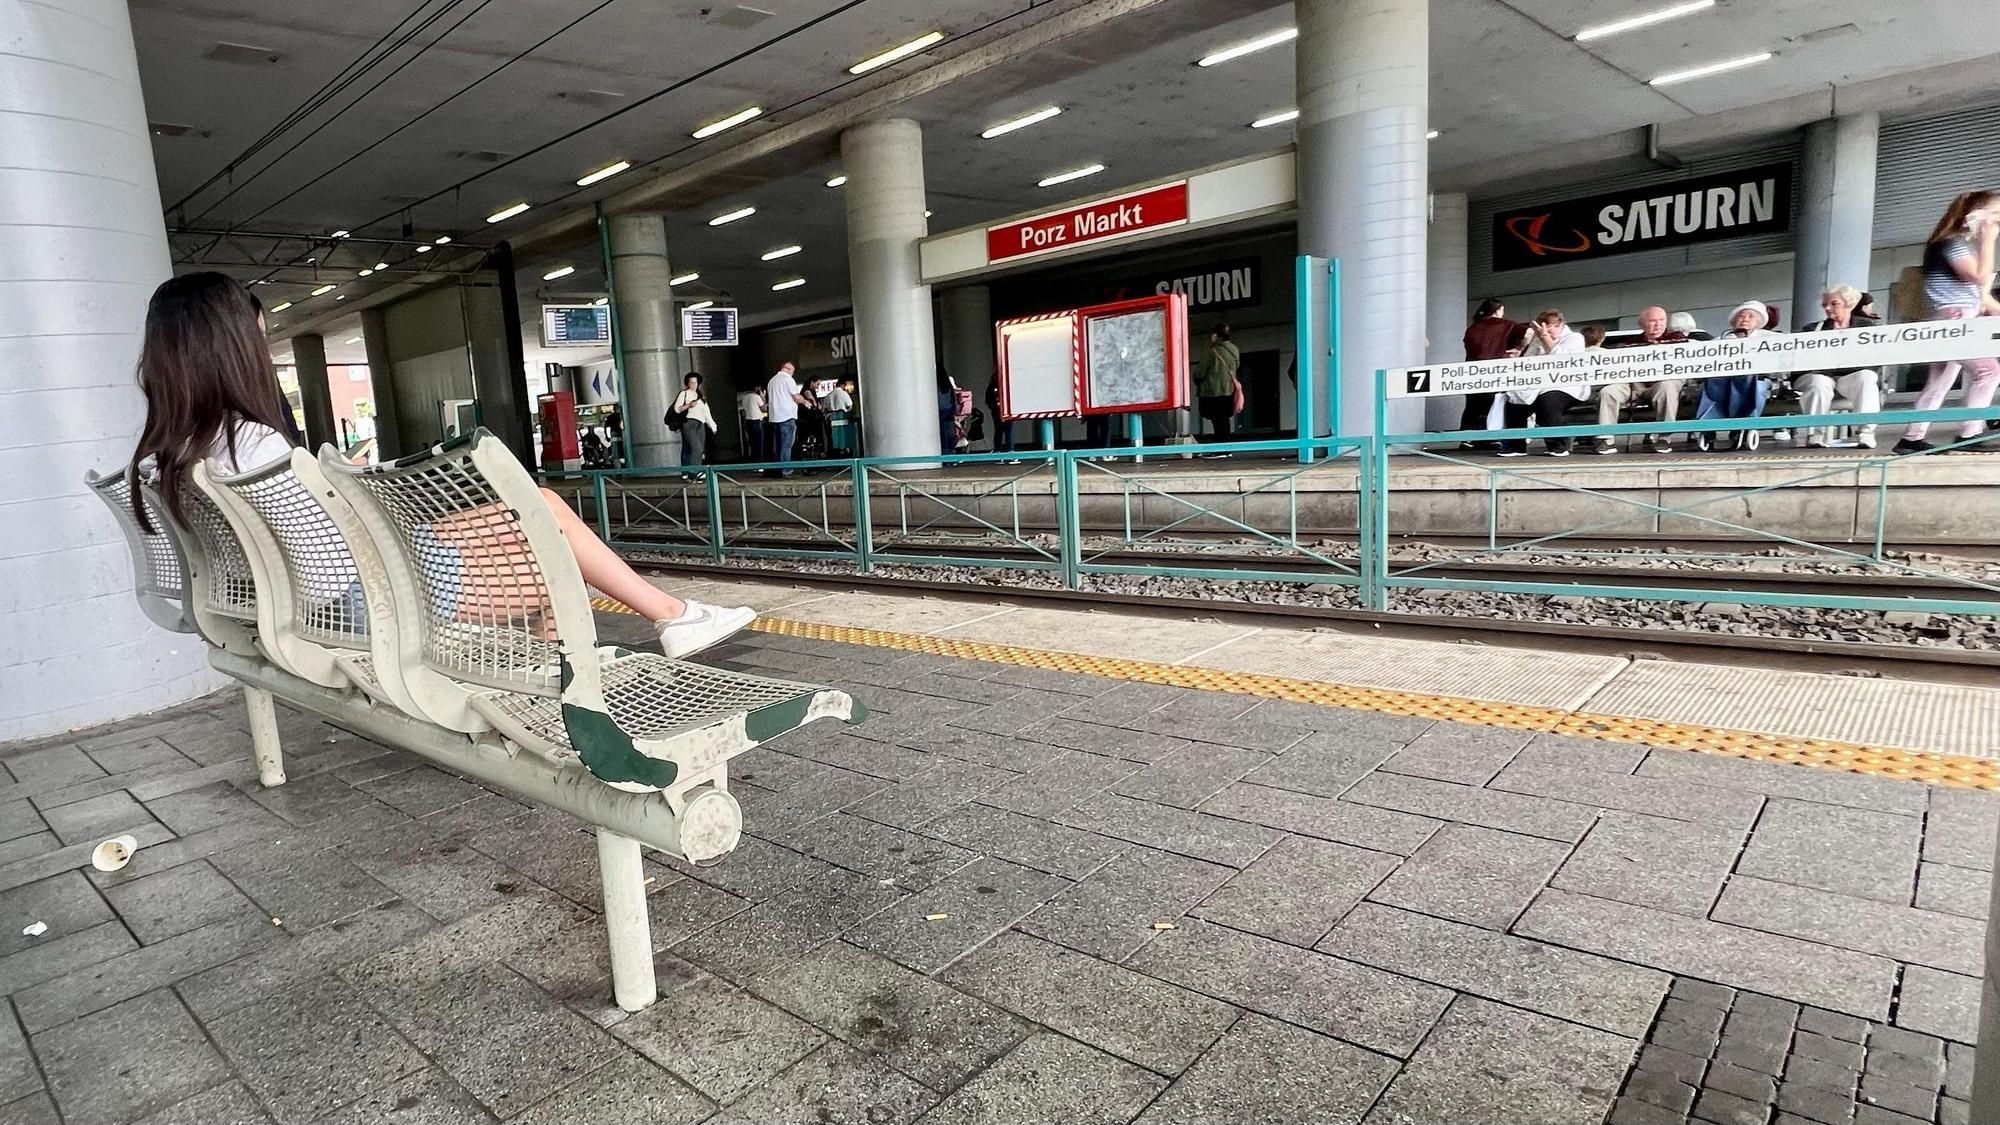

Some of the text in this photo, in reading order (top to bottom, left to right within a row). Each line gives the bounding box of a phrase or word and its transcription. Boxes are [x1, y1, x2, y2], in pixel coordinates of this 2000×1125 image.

[1020, 203, 1144, 249] Porz Markt
[1597, 178, 1776, 245] SATURN
[1856, 323, 1975, 346] Str./Gürtel-
[1410, 371, 1428, 391] 7
[1441, 358, 1752, 392] Marsdorf-Haus Vorst-Frechen-Benzelrath
